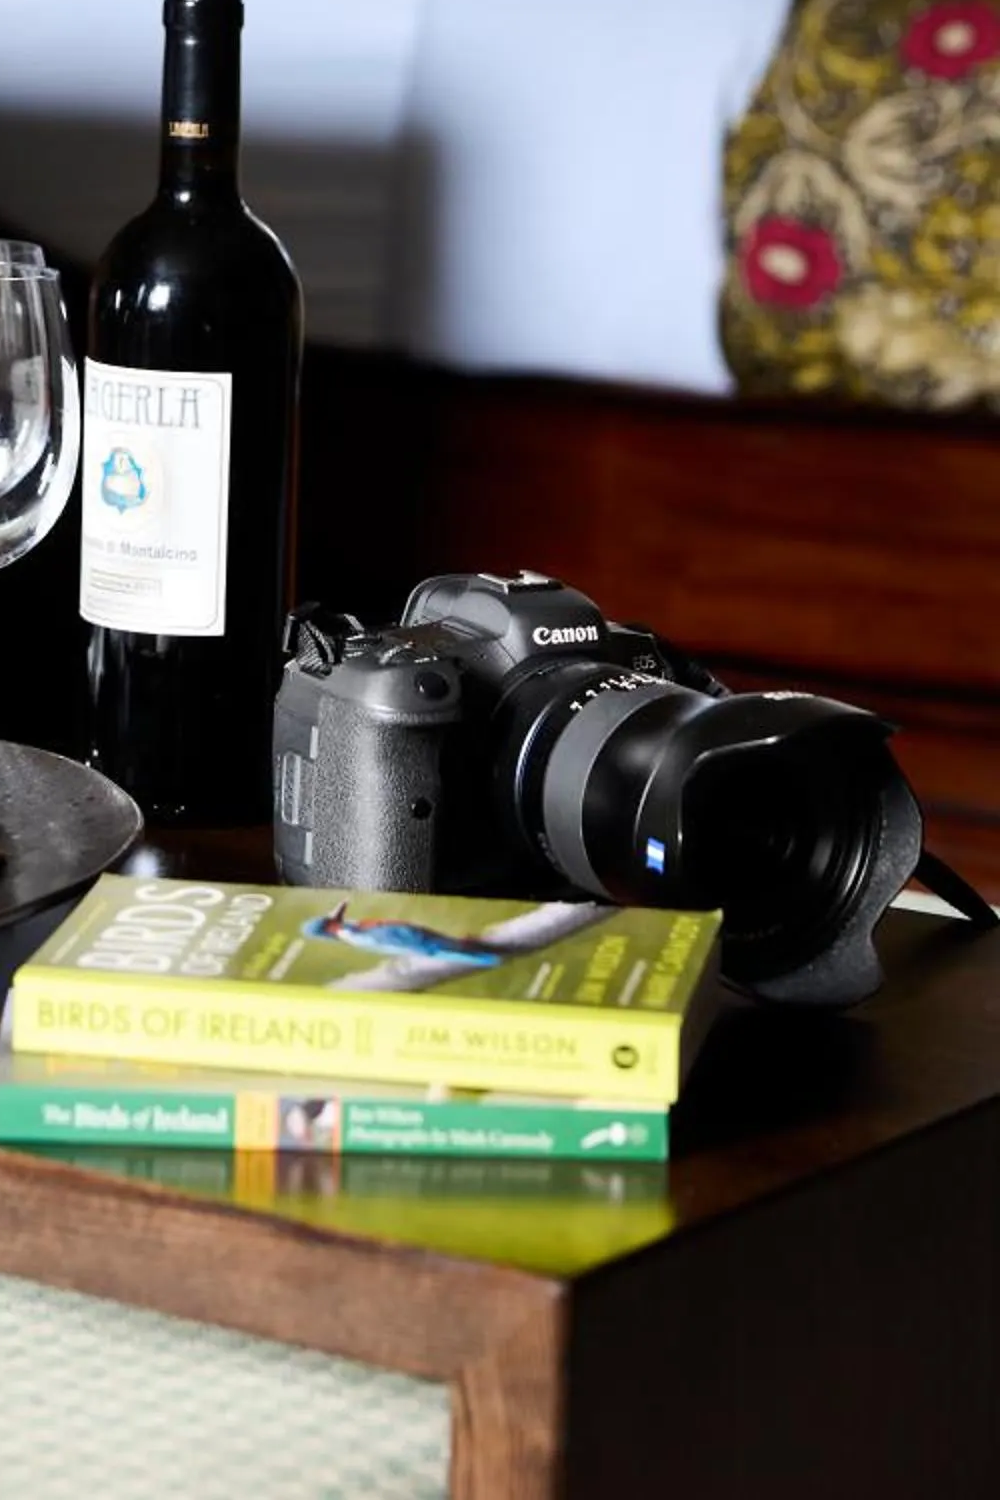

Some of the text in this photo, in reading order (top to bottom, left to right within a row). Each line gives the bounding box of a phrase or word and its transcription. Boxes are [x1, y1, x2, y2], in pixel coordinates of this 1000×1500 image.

[101, 380, 202, 429] GERLA
[533, 625, 599, 646] Canon
[76, 884, 225, 973] BIRDS
[37, 999, 132, 1034] BIRDS
[141, 1007, 186, 1038] OF
[200, 1011, 342, 1050] IRELAND
[407, 1025, 577, 1056] JIM WILSON
